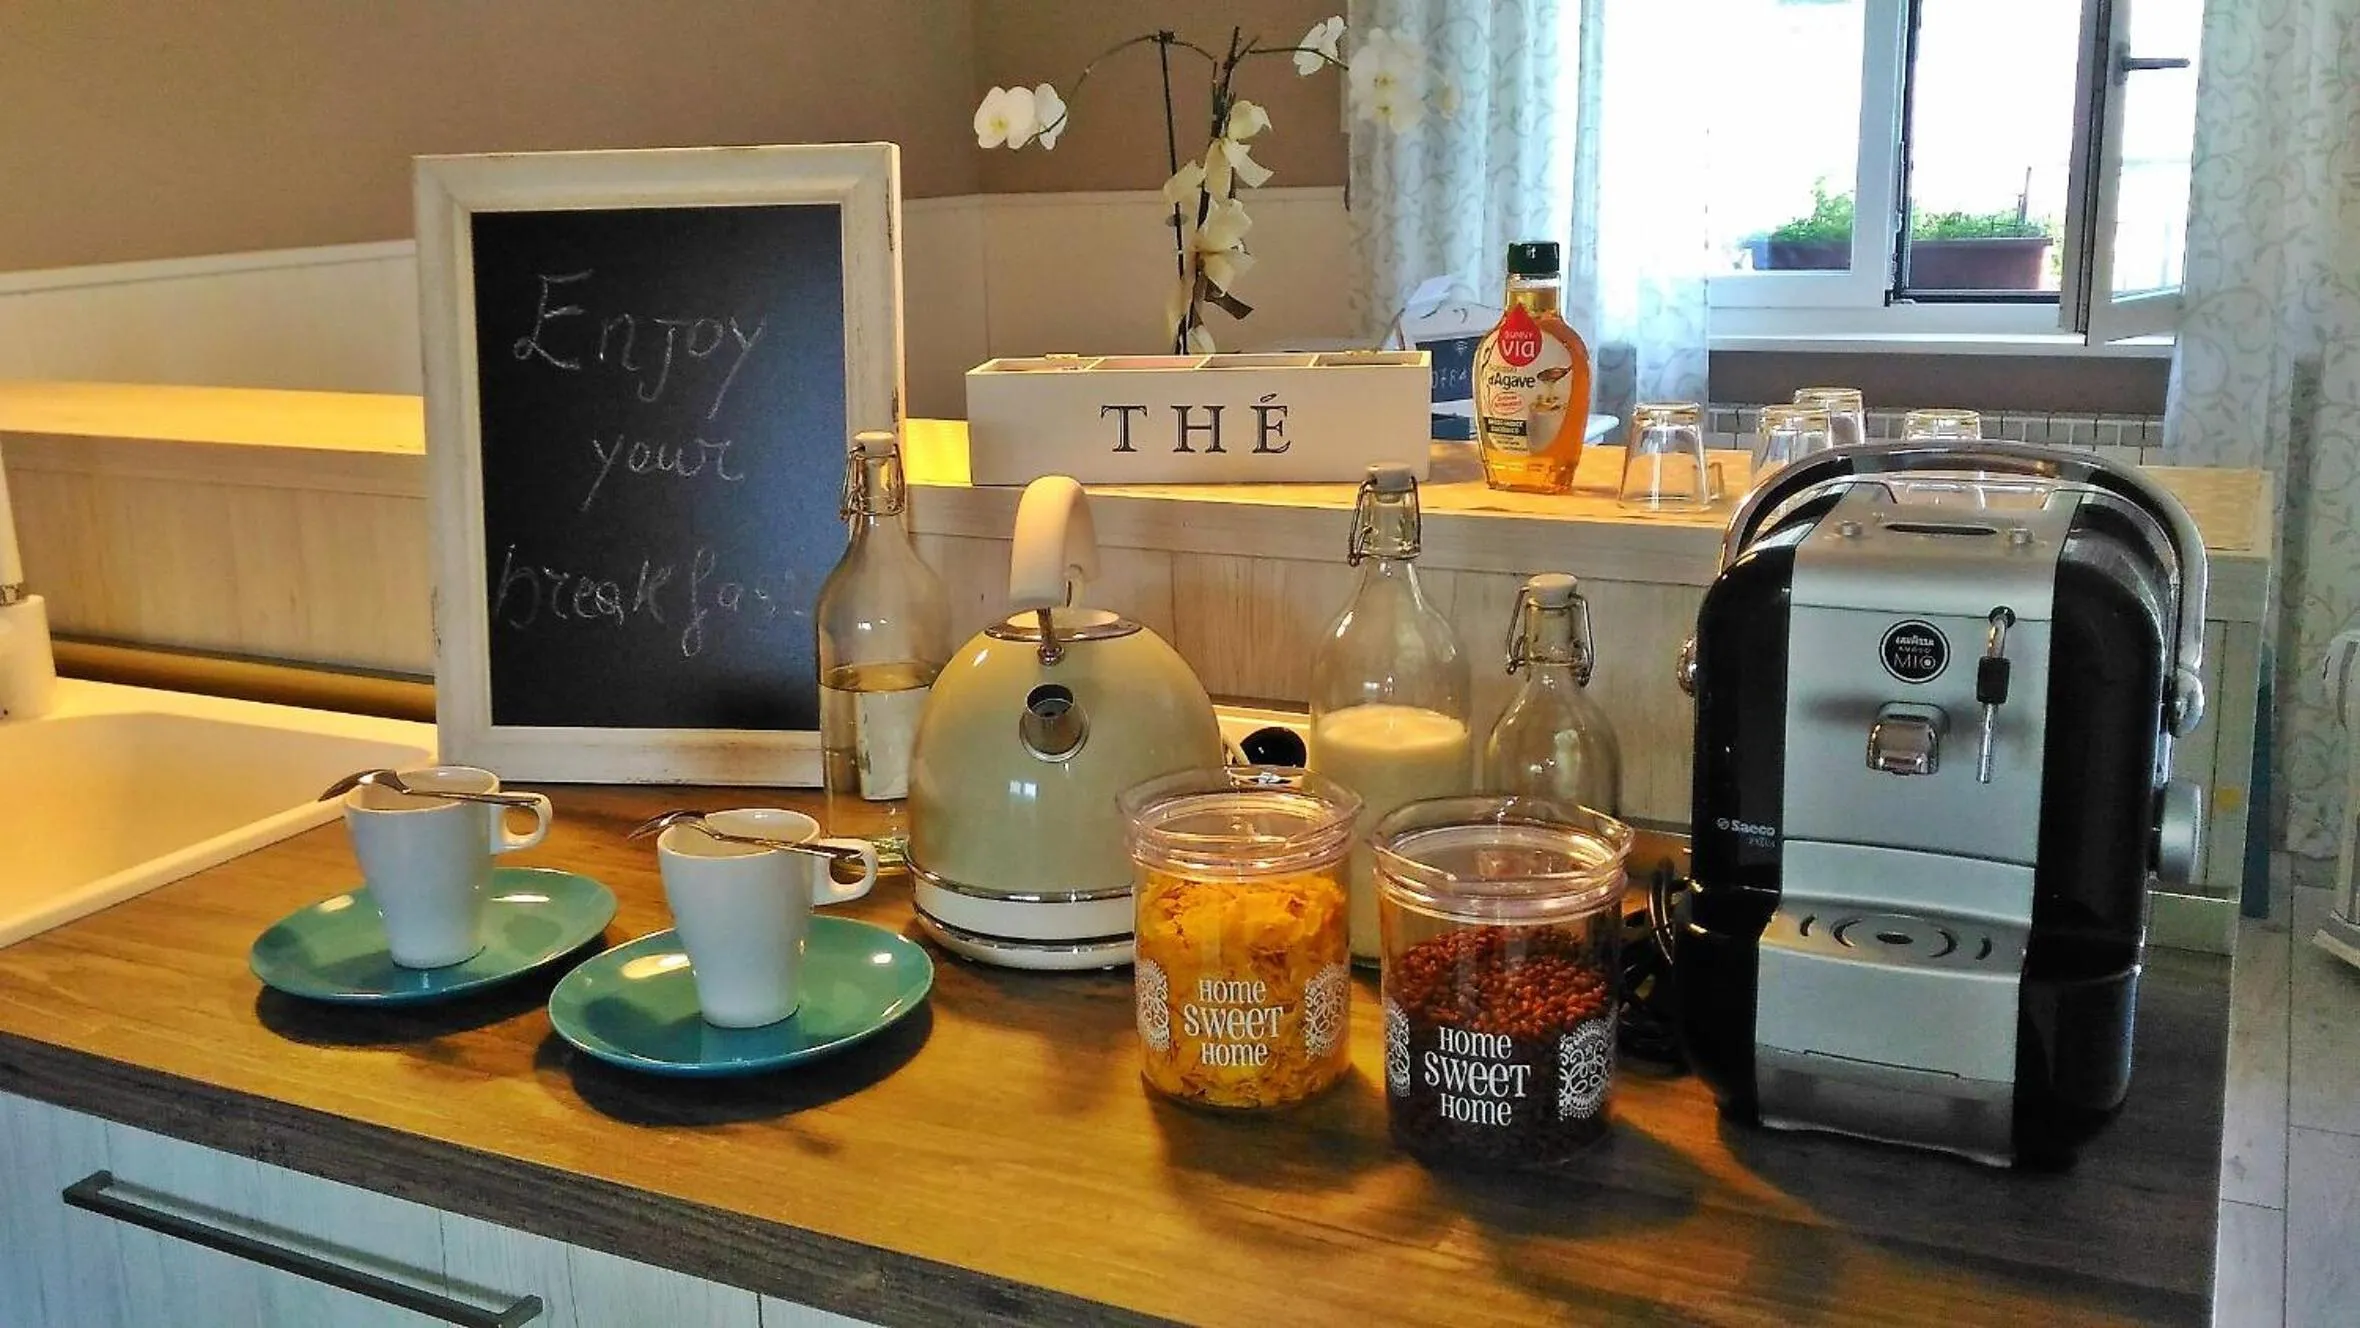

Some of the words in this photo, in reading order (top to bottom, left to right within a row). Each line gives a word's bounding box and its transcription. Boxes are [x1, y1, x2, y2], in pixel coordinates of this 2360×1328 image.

[514, 269, 767, 420] Enjoy
[1100, 392, 1291, 454] THÉ
[579, 434, 744, 512] your
[1731, 819, 1776, 836] Saeco
[1199, 979, 1267, 1004] Home
[1201, 1042, 1269, 1066] Home
[1440, 1026, 1512, 1059] Home
[1440, 1093, 1512, 1126] Home
